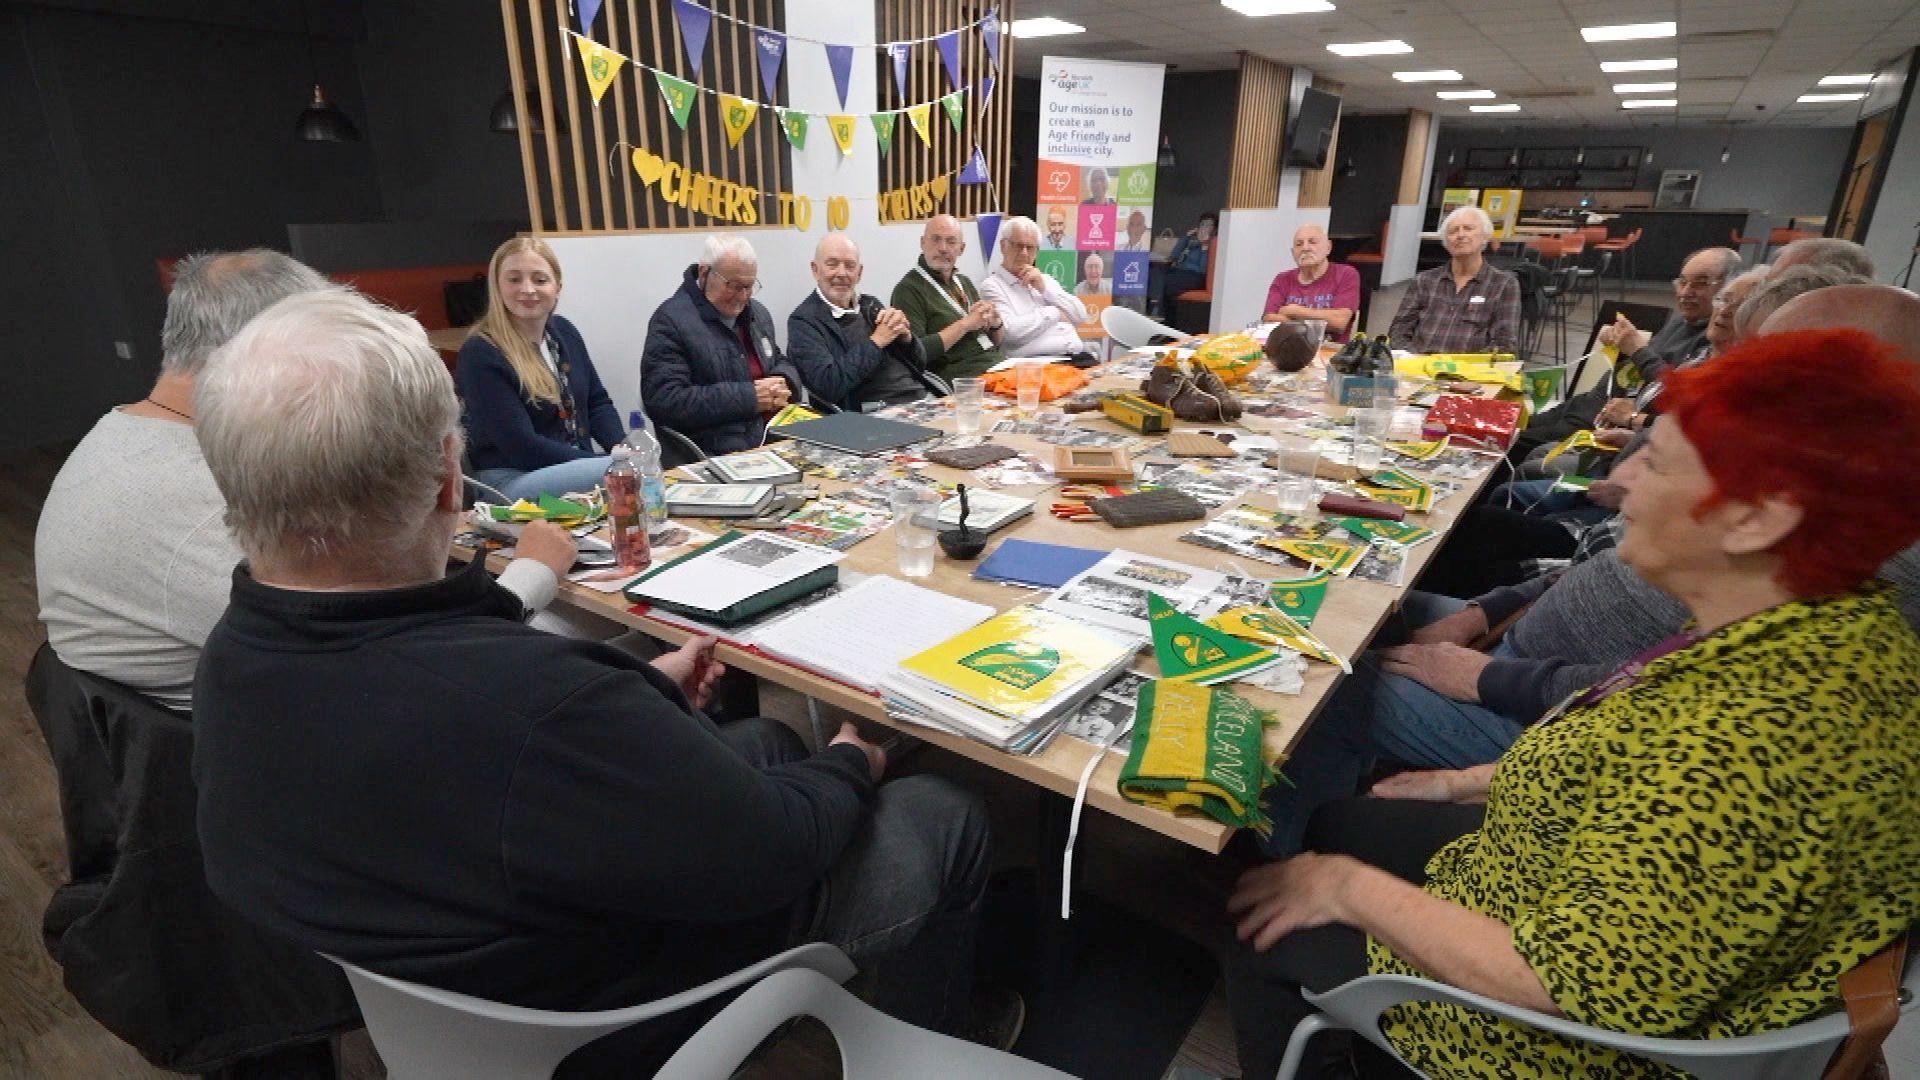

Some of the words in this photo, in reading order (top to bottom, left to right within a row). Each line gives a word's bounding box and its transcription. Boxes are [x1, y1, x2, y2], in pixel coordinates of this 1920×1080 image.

[1049, 102, 1069, 113] Our
[1071, 103, 1109, 115] mission
[1111, 105, 1120, 115] is
[1122, 107, 1133, 117] to
[1048, 118, 1081, 127] create
[1083, 119, 1095, 127] an
[1048, 129, 1068, 142] Age
[1071, 130, 1109, 144] Friendly
[1112, 131, 1131, 142] and
[1048, 142, 1092, 154] inclusive
[661, 162, 757, 225] CHEERS
[778, 192, 812, 231] TO
[877, 182, 934, 226] YARS
